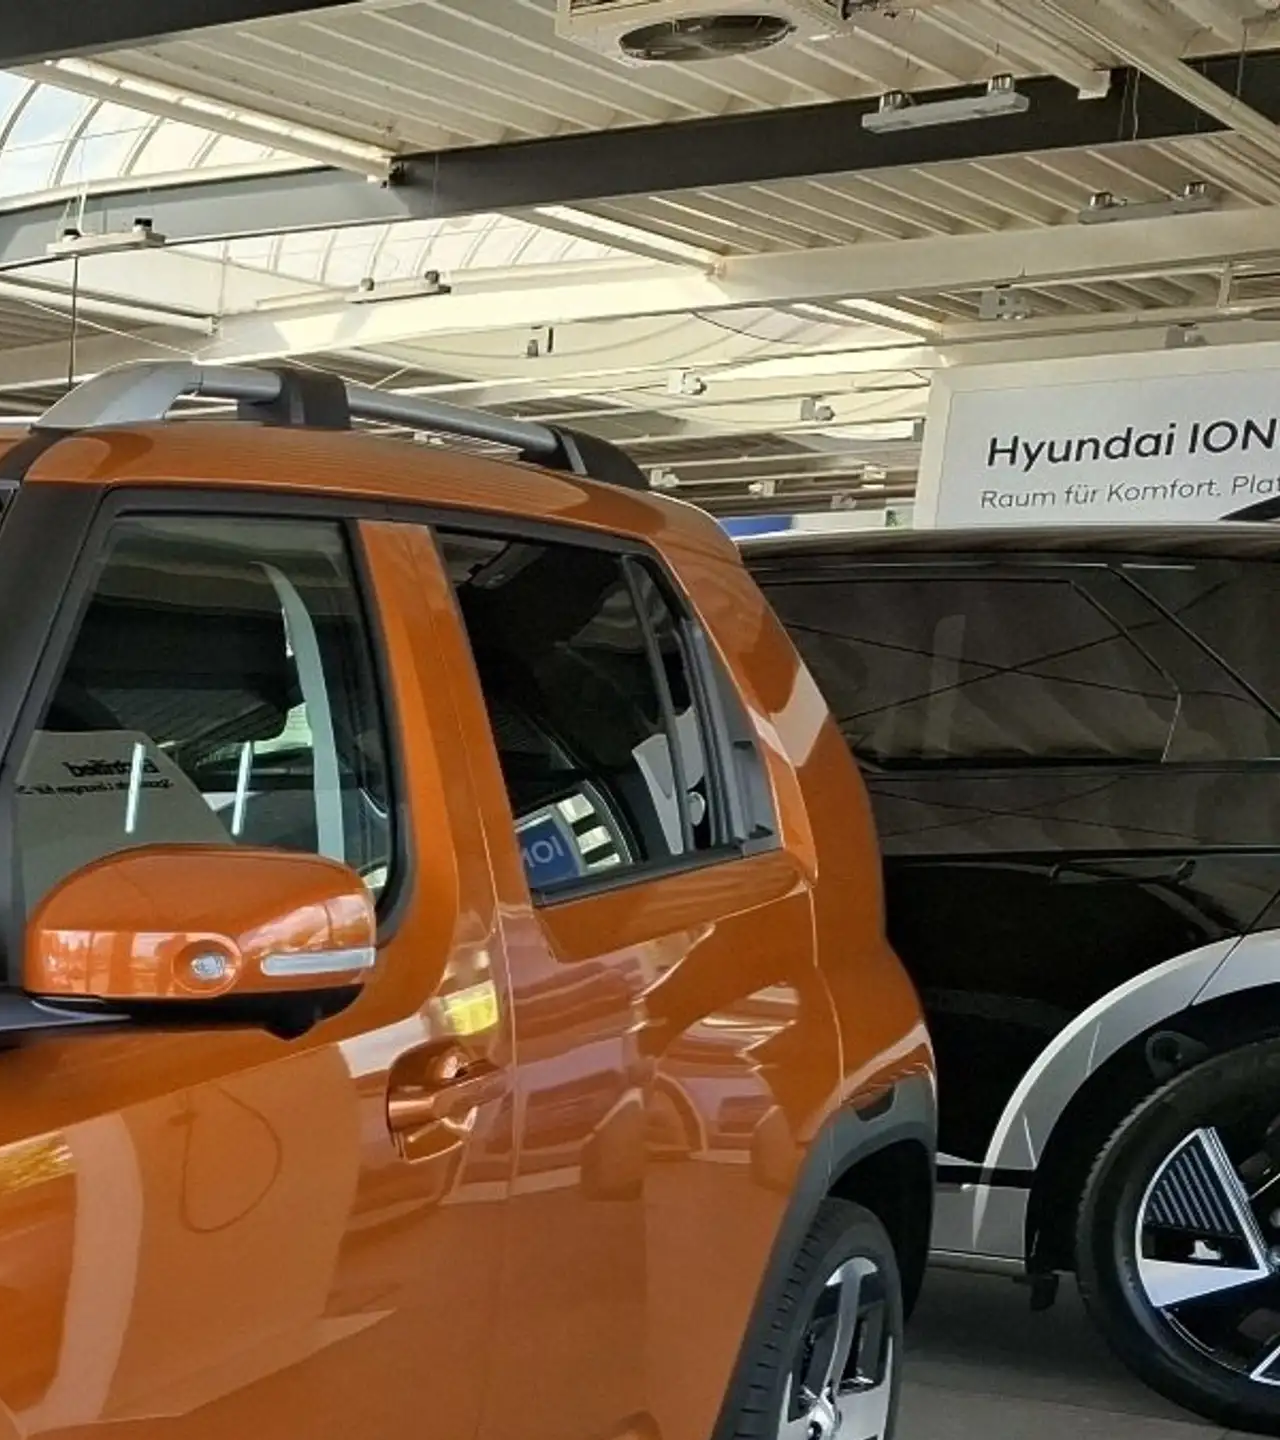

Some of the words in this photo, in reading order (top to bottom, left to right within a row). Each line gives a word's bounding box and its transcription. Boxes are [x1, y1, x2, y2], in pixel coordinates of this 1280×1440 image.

[987, 422, 1177, 472] Hyundai
[1188, 417, 1278, 454] ION
[980, 489, 1057, 509] Raum
[1064, 484, 1099, 505] für
[1106, 478, 1222, 503] Komfort.
